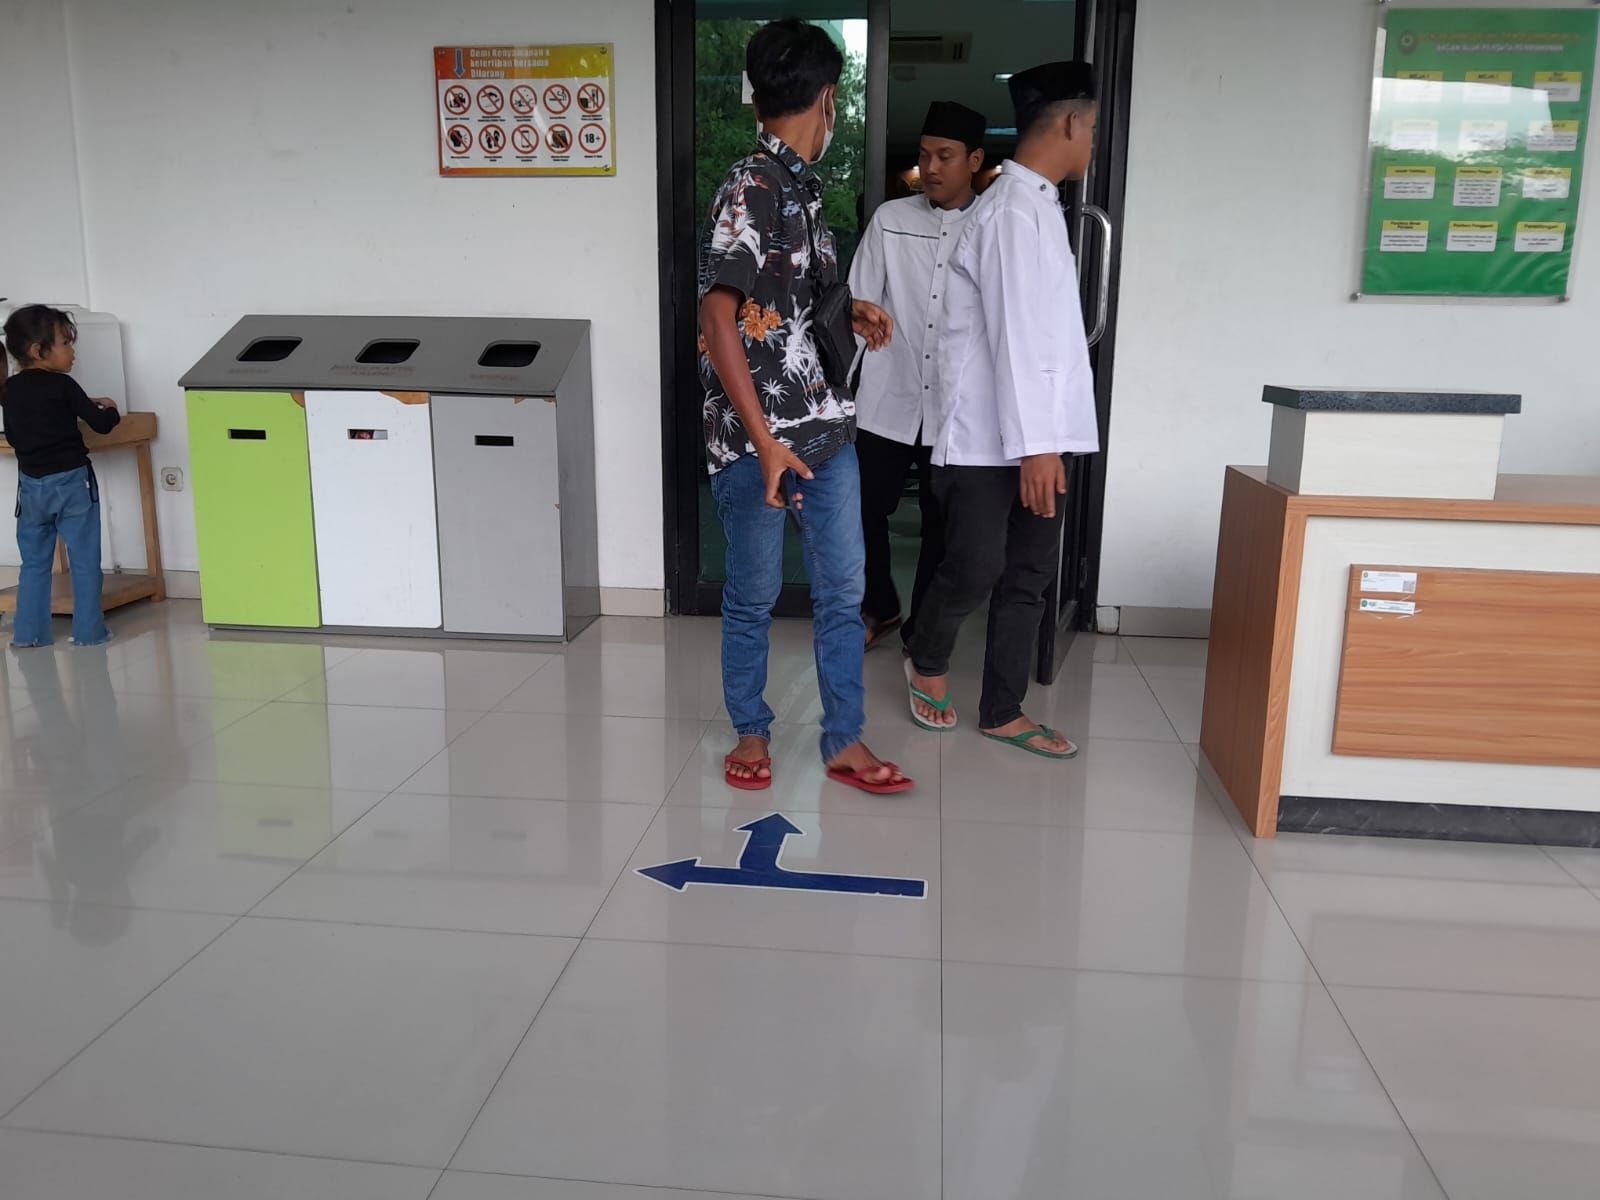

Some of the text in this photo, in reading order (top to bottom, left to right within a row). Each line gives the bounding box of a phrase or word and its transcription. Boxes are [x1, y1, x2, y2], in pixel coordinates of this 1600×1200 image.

[470, 49, 490, 57] Demi
[492, 49, 544, 58] Kenyamanan
[471, 69, 505, 78] Dilarang
[584, 133, 601, 144] 18+
